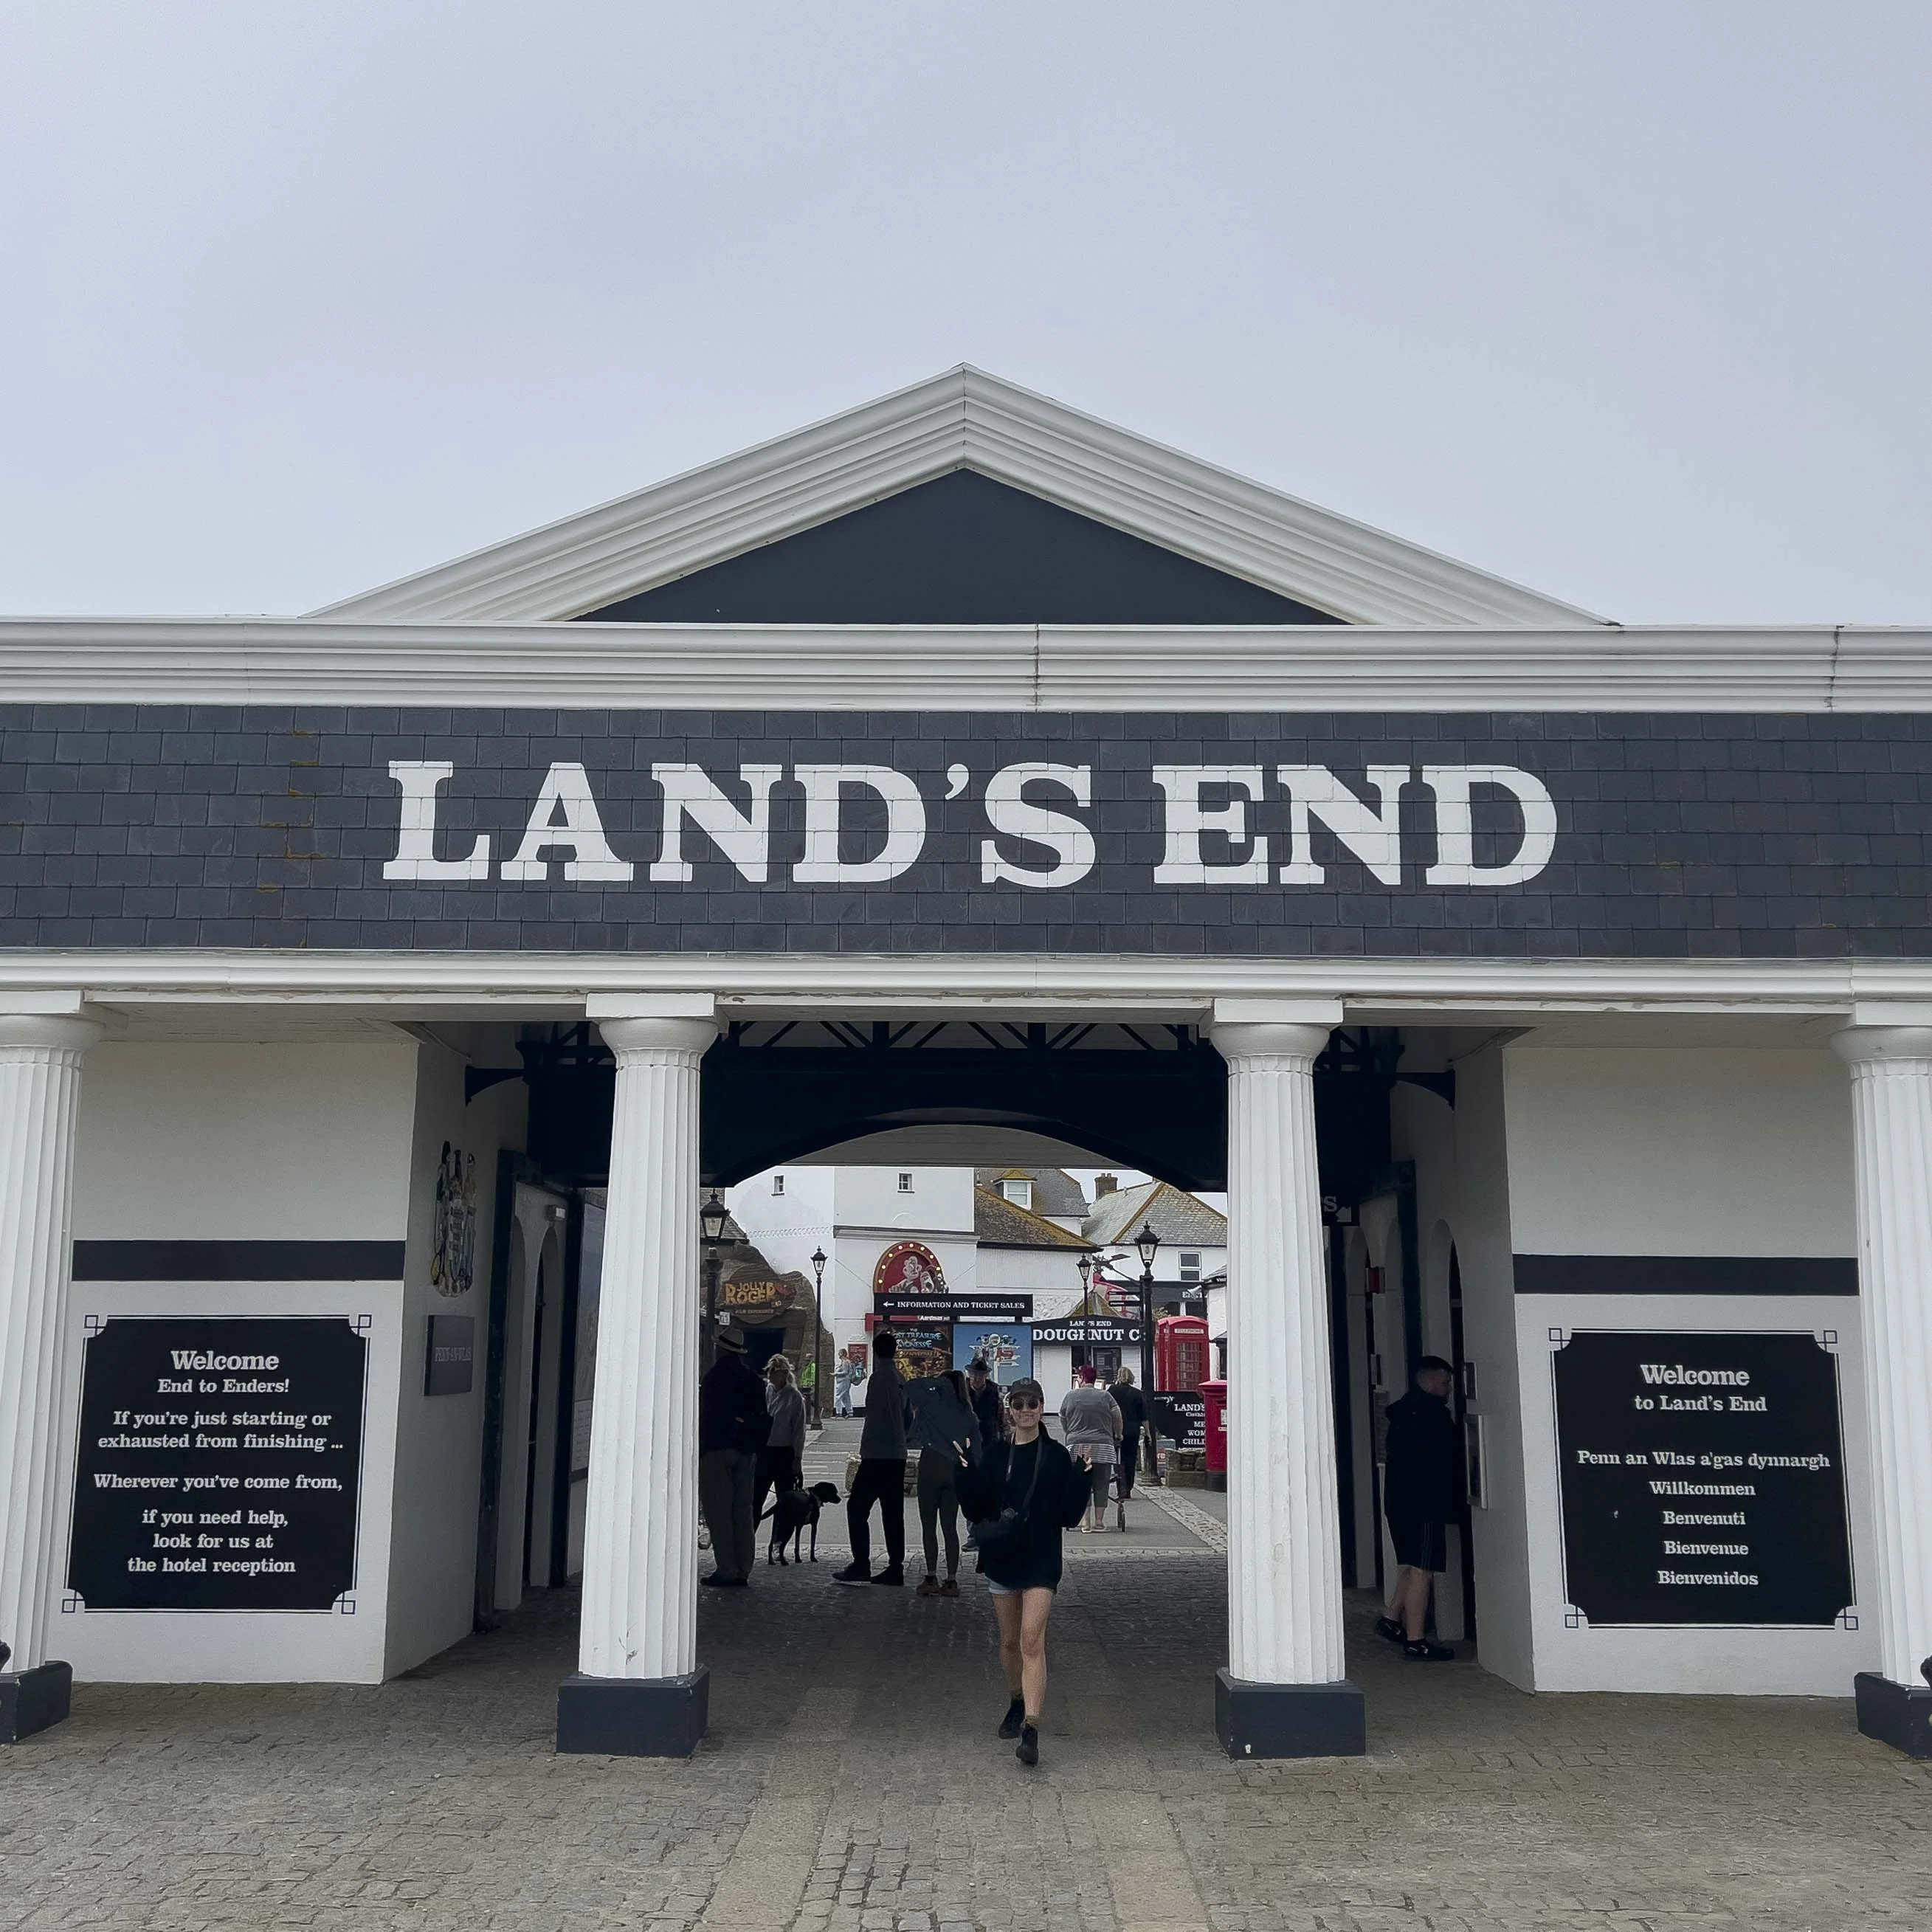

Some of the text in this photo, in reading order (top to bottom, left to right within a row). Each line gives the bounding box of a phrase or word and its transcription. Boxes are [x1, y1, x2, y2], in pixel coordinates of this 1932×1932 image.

[382, 760, 1557, 888] LAND'S END
[725, 1283, 776, 1305] ROGER
[737, 1282, 765, 1291] JOLLY
[170, 1350, 280, 1370] Welcome
[1640, 1364, 1750, 1386] Welcome
[157, 1378, 289, 1393] End to Enders!
[1634, 1395, 1767, 1412] to Land's End
[113, 1410, 332, 1429] If you're just starting or
[97, 1433, 190, 1448] exhausted
[195, 1433, 238, 1448] from
[243, 1433, 328, 1452] finishing
[1577, 1450, 1621, 1464] Penn
[1625, 1454, 1649, 1465] an
[1652, 1452, 1696, 1466] Wlas
[1748, 1453, 1831, 1471] dynnargh
[94, 1474, 342, 1492] Wherever you've come from,
[1649, 1481, 1756, 1496] Willkommen
[142, 1508, 289, 1528] if you need help,
[1663, 1511, 1746, 1525] Benvenuti
[153, 1533, 274, 1548] look for us at
[1663, 1540, 1749, 1555] Bienvenue
[128, 1557, 296, 1576] the hotel reception
[1657, 1570, 1759, 1585] Bienvenidos
